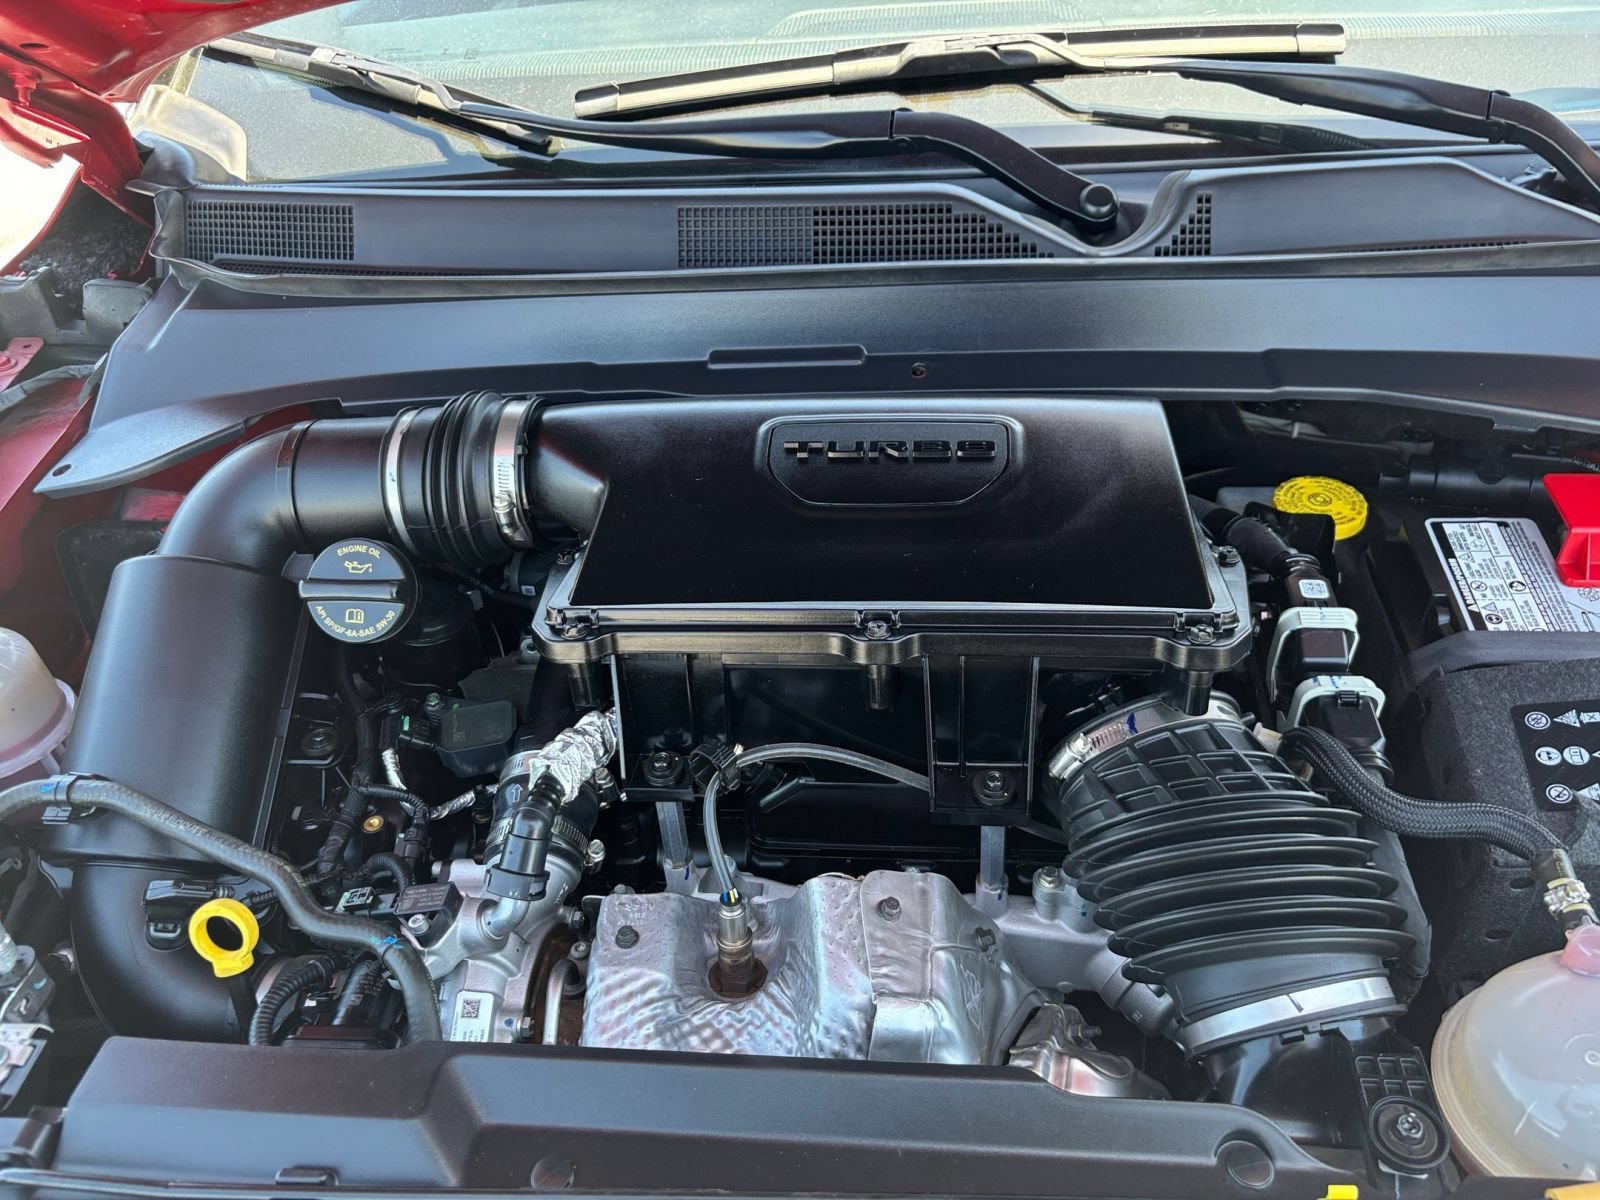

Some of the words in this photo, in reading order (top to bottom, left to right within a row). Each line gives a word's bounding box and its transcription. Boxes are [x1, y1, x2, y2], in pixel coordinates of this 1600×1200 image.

[783, 440, 996, 459] TURBO
[336, 545, 368, 557] ENGINE
[368, 547, 381, 559] OIL
[315, 605, 327, 619] API
[376, 610, 396, 630] 5W-30
